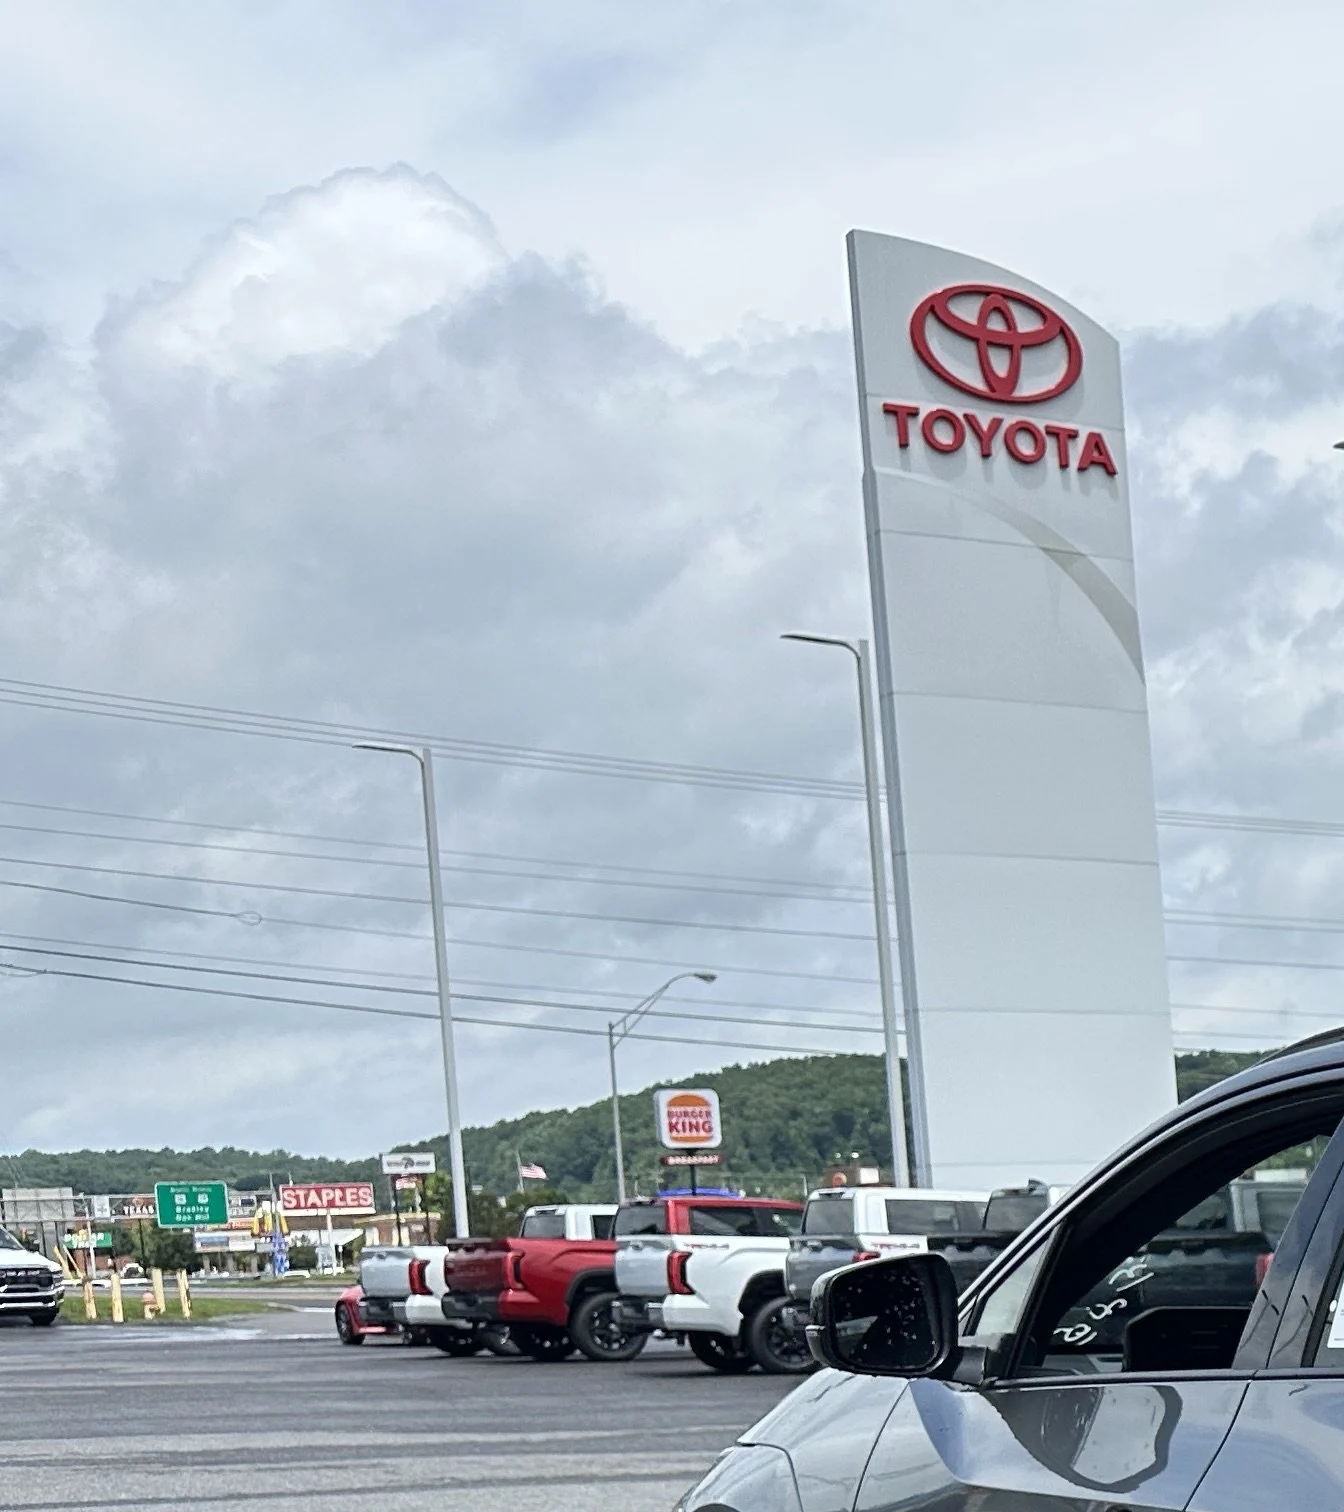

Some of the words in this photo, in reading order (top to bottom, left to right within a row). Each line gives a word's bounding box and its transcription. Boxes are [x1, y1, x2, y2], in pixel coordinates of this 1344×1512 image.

[883, 402, 1118, 476] TOYOTA
[668, 1110, 712, 1119] BURGER
[669, 1121, 713, 1133] KING
[282, 1187, 372, 1208] STAPLES
